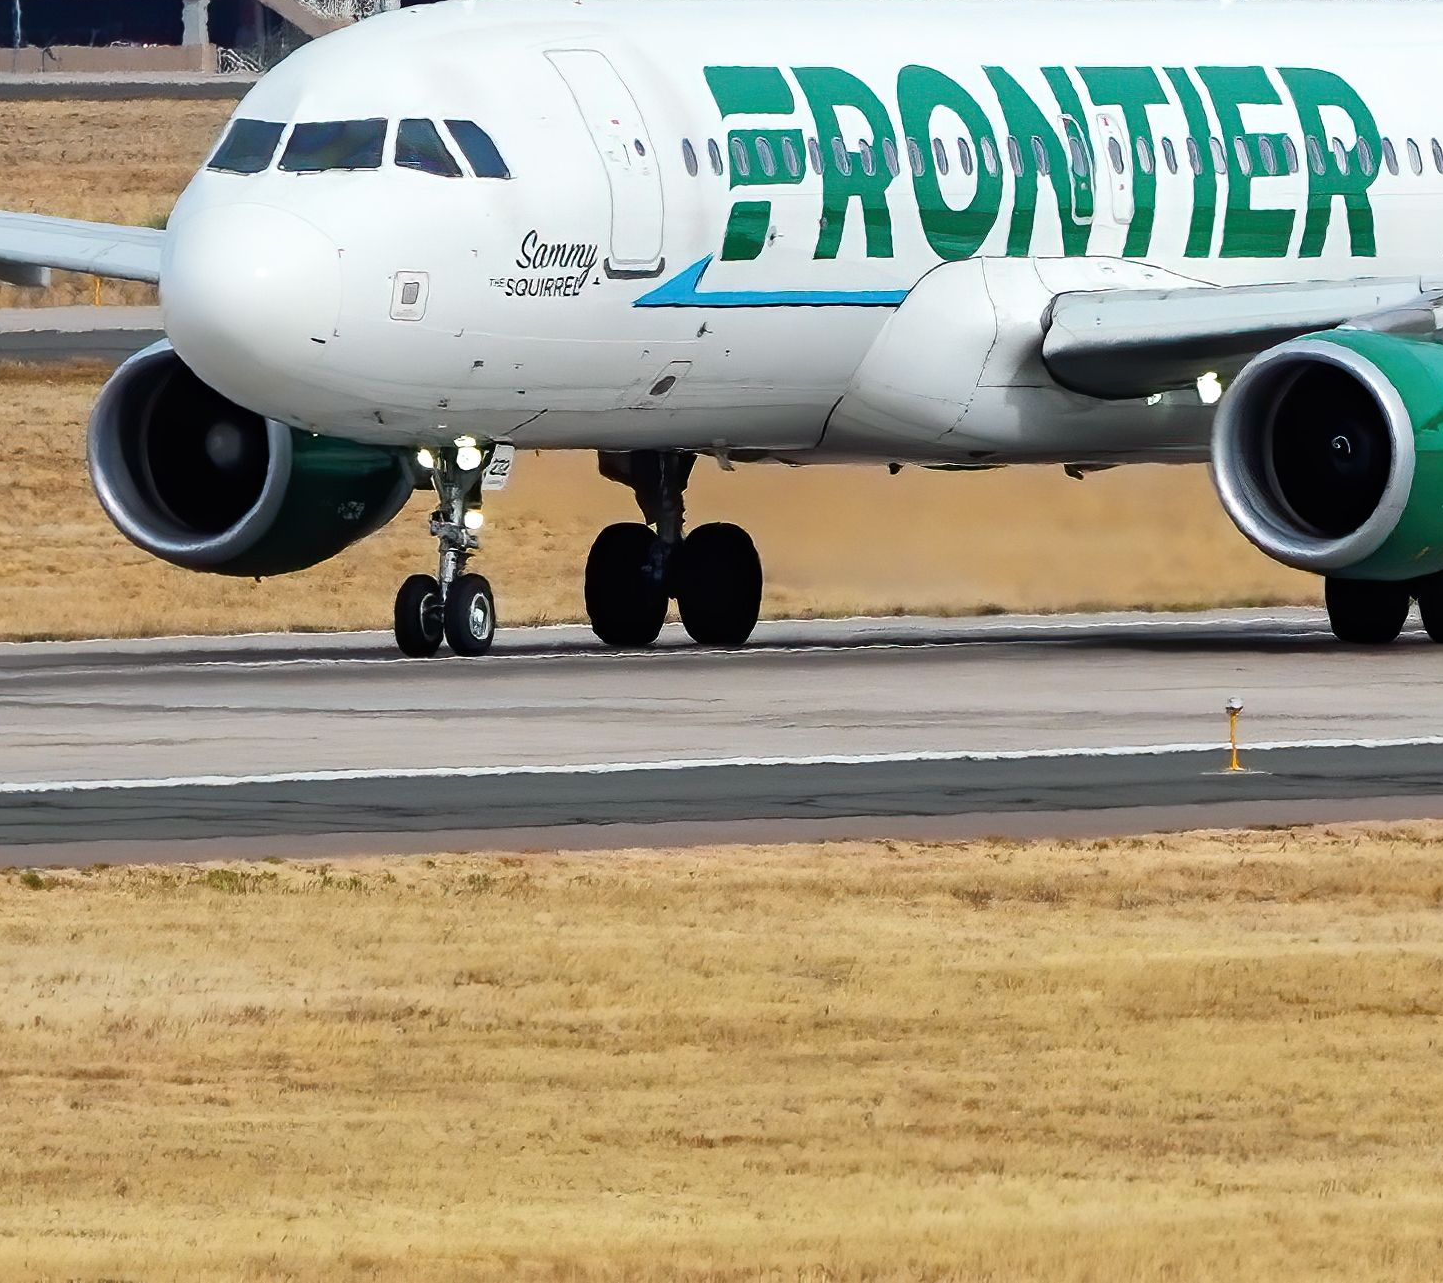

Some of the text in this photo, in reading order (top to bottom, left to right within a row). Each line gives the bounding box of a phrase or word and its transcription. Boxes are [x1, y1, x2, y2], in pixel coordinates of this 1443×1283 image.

[703, 64, 1382, 261] FRONTIER
[505, 276, 581, 297] SQUIRREL
[515, 229, 598, 289] Sammy
